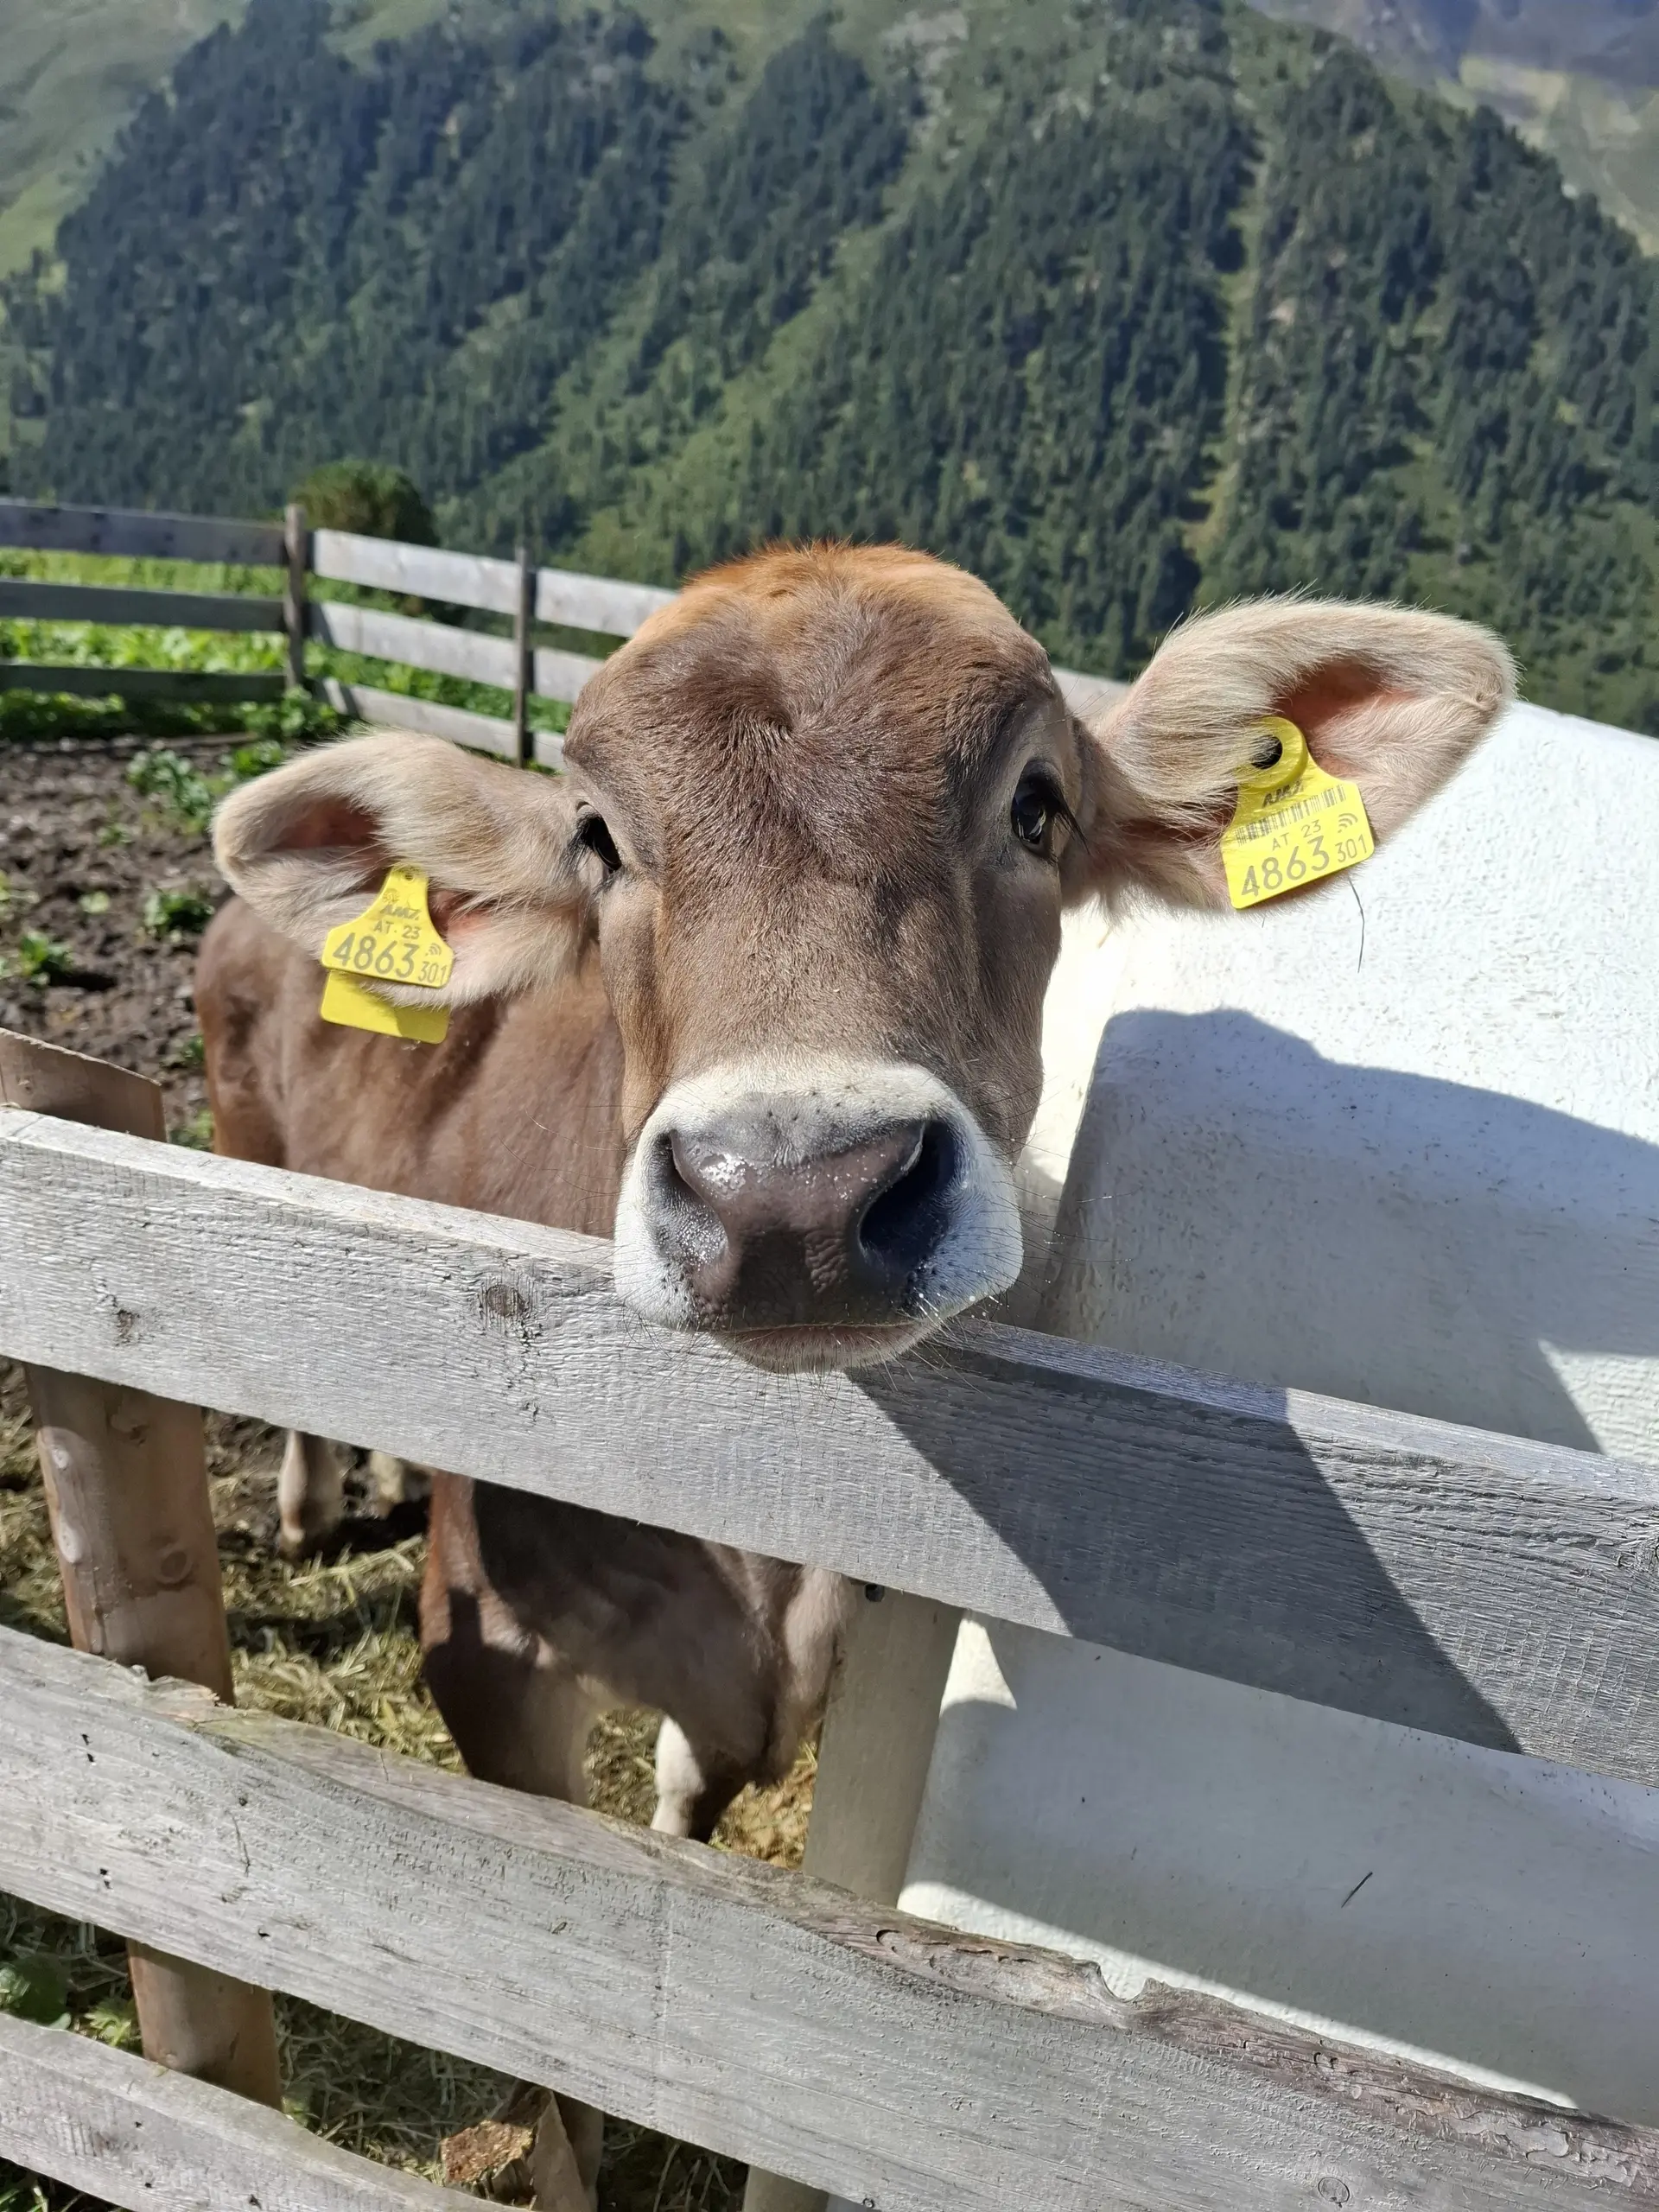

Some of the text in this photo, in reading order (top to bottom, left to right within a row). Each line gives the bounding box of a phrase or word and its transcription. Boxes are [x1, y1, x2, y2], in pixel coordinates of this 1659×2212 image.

[1272, 819, 1322, 851] AT 23
[1241, 834, 1368, 898] 4863 301
[402, 925, 422, 939] 23
[333, 932, 447, 984] 4863 301
